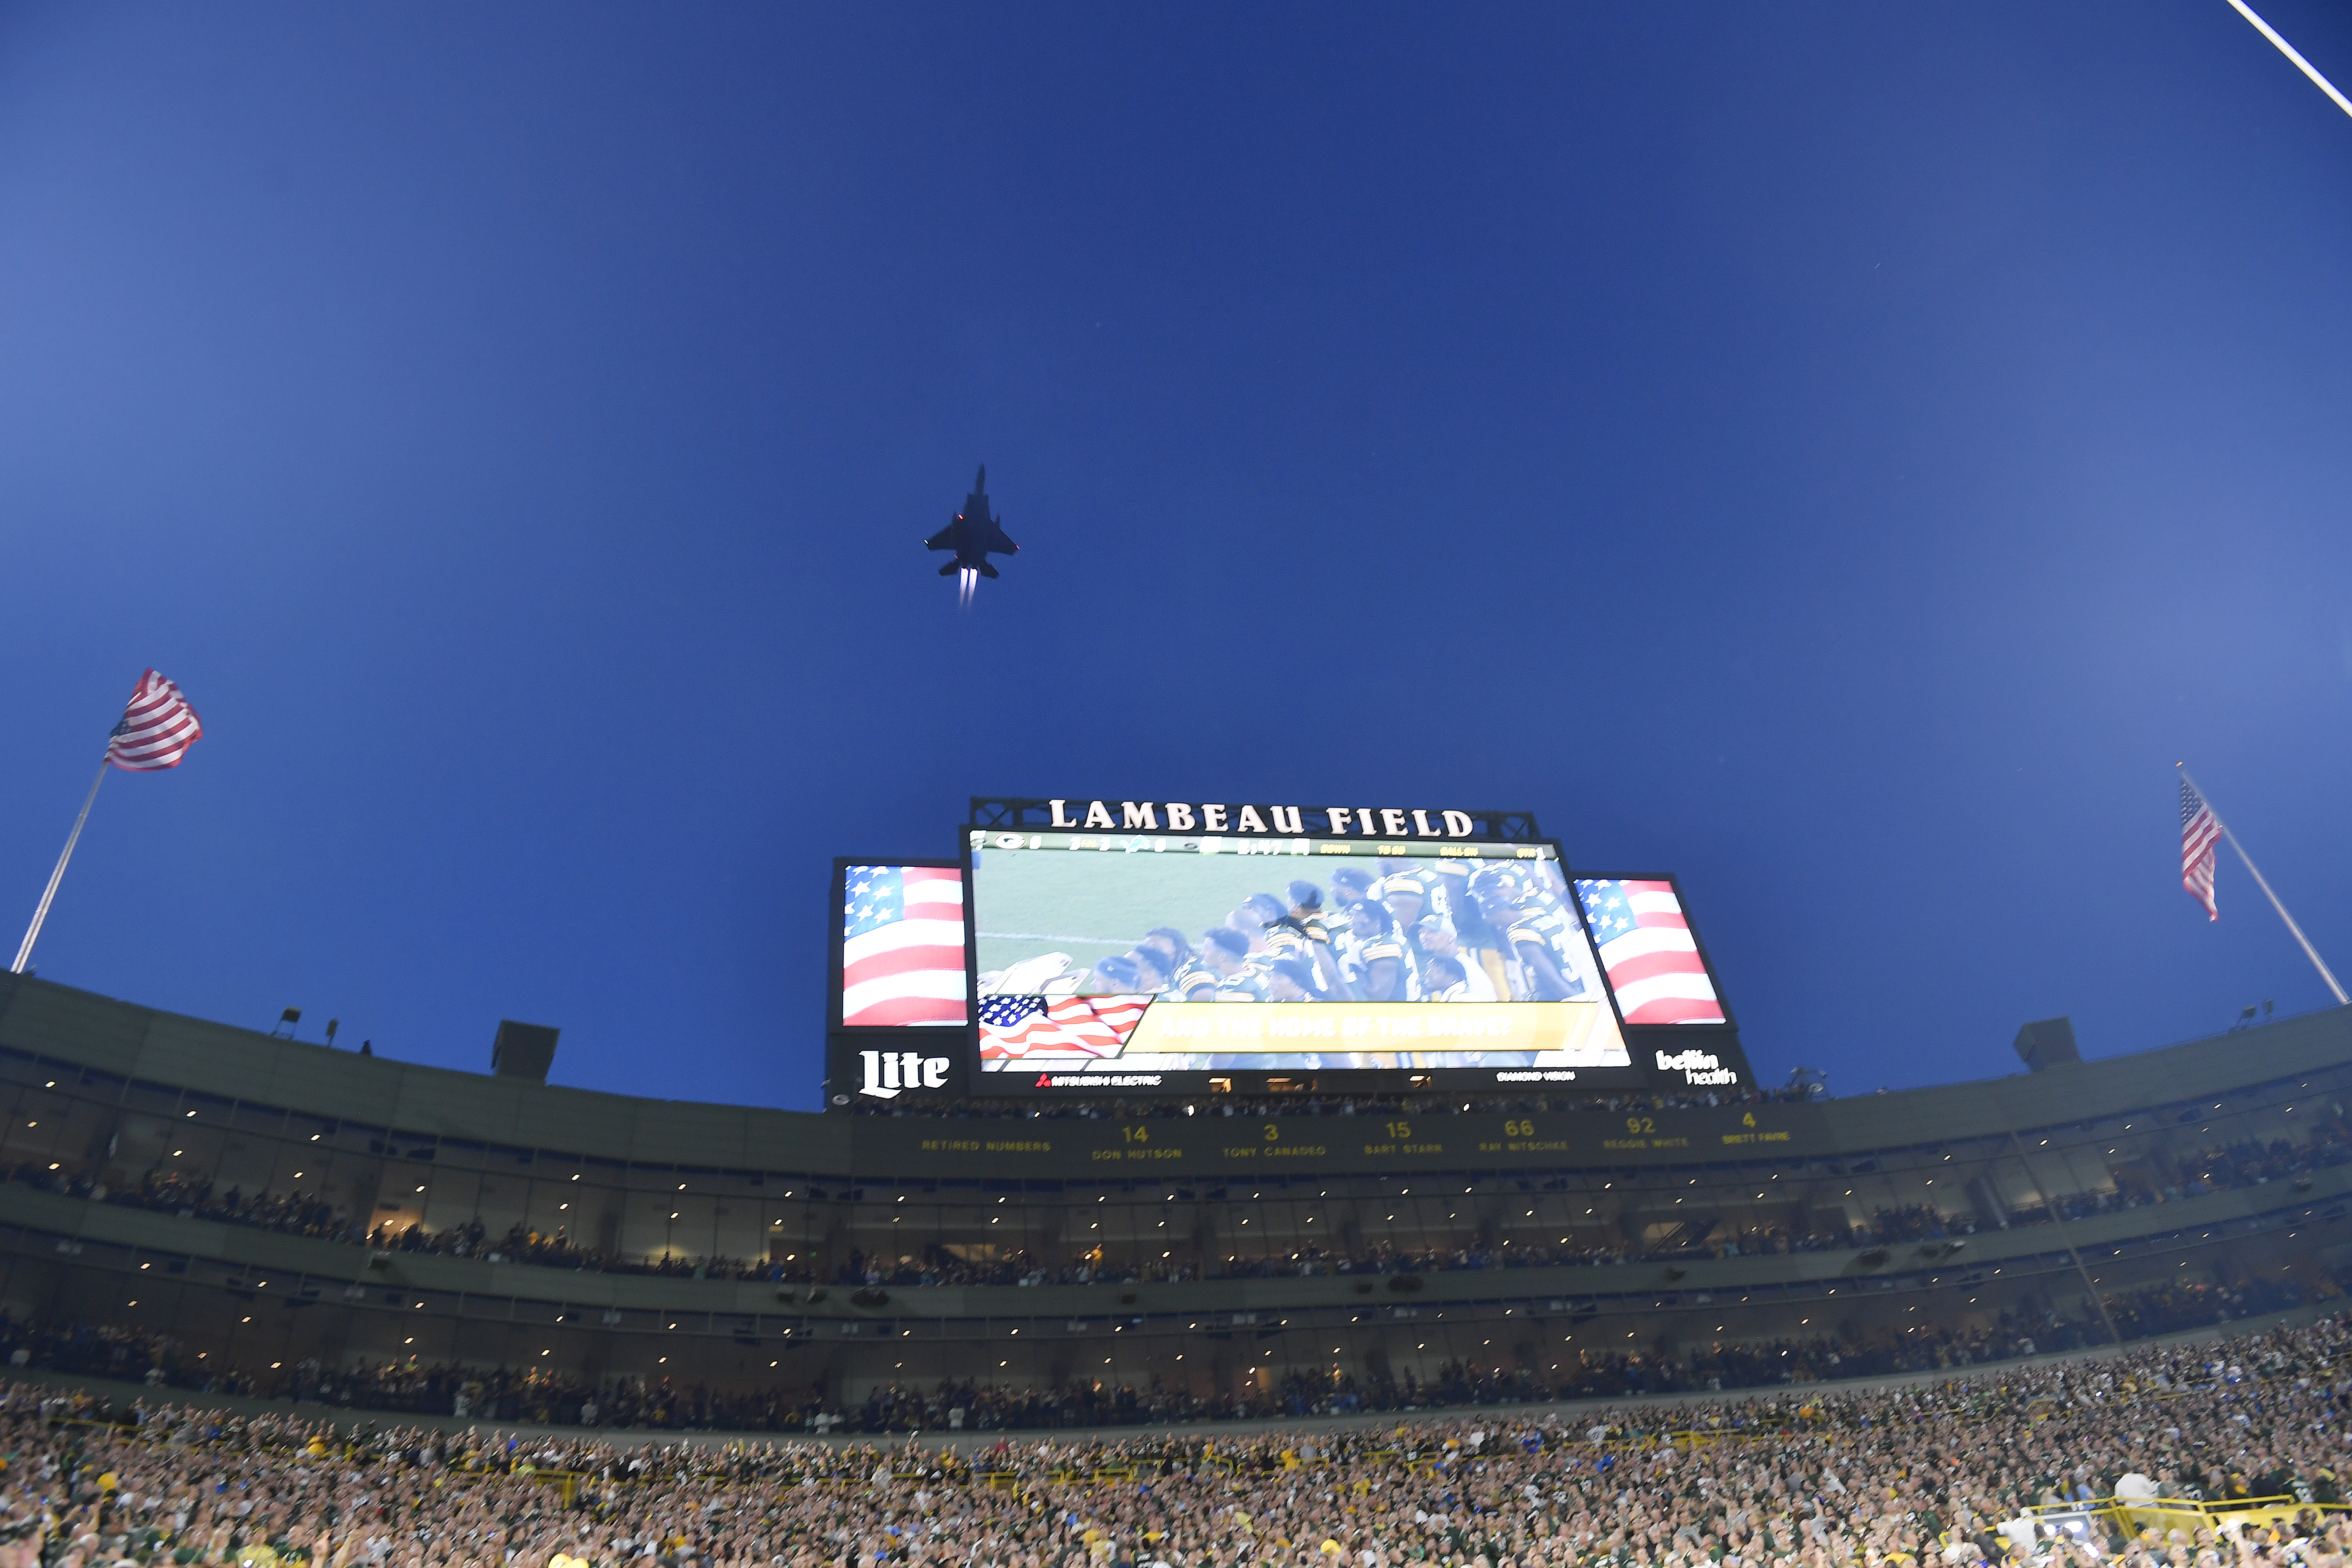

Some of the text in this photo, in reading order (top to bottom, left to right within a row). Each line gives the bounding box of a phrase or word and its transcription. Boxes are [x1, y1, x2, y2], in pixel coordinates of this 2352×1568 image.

[1048, 798, 1473, 838] LAMBEAU FIELD
[1159, 1016, 1210, 1037] AND
[1216, 1016, 1263, 1037] THE
[1269, 1016, 1337, 1037] HOME
[1342, 1016, 1372, 1037] OF
[1377, 1016, 1423, 1037] THE
[1655, 1049, 1719, 1070] bellin
[858, 1050, 950, 1099] Lite
[1051, 1075, 1162, 1087] MITSUBISHI ELECTRIC
[1496, 1071, 1576, 1082] DIAMOND VISION
[1685, 1067, 1737, 1085] health
[1505, 1120, 1534, 1137] 66
[1626, 1118, 1655, 1134] 92
[1742, 1112, 1756, 1128] 4
[1122, 1125, 1149, 1143] 14
[1264, 1124, 1279, 1141] 3
[1386, 1122, 1412, 1138] 15
[923, 1140, 1051, 1152] RETIRED NUMBERS
